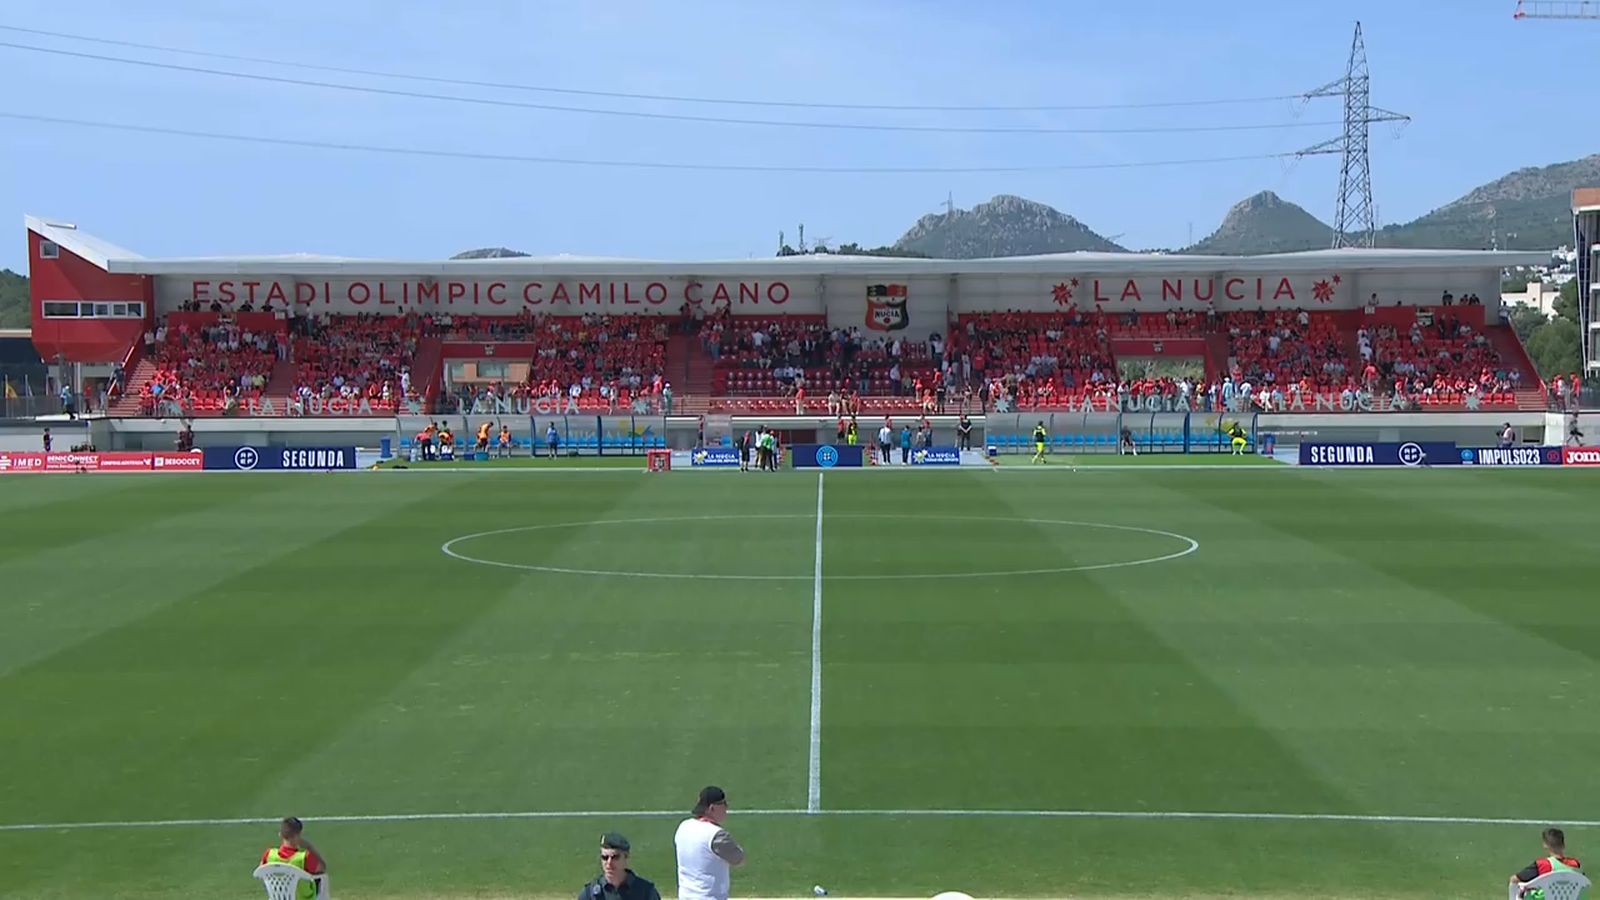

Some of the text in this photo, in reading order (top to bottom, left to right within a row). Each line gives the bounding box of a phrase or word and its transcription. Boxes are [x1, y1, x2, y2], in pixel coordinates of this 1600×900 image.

[192, 281, 790, 305] ESTADI OLIMPIC CAMILO CANO
[1093, 277, 1296, 302] LA NUCIA
[249, 396, 276, 416] LA
[459, 396, 483, 415] LA
[1069, 395, 1095, 413] LA
[1278, 393, 1305, 411] LA
[13, 458, 42, 467] IMED
[283, 450, 344, 467] SEGUNDA
[1311, 446, 1374, 463] SEGUNDA
[1478, 449, 1541, 465] IMPULSO23
